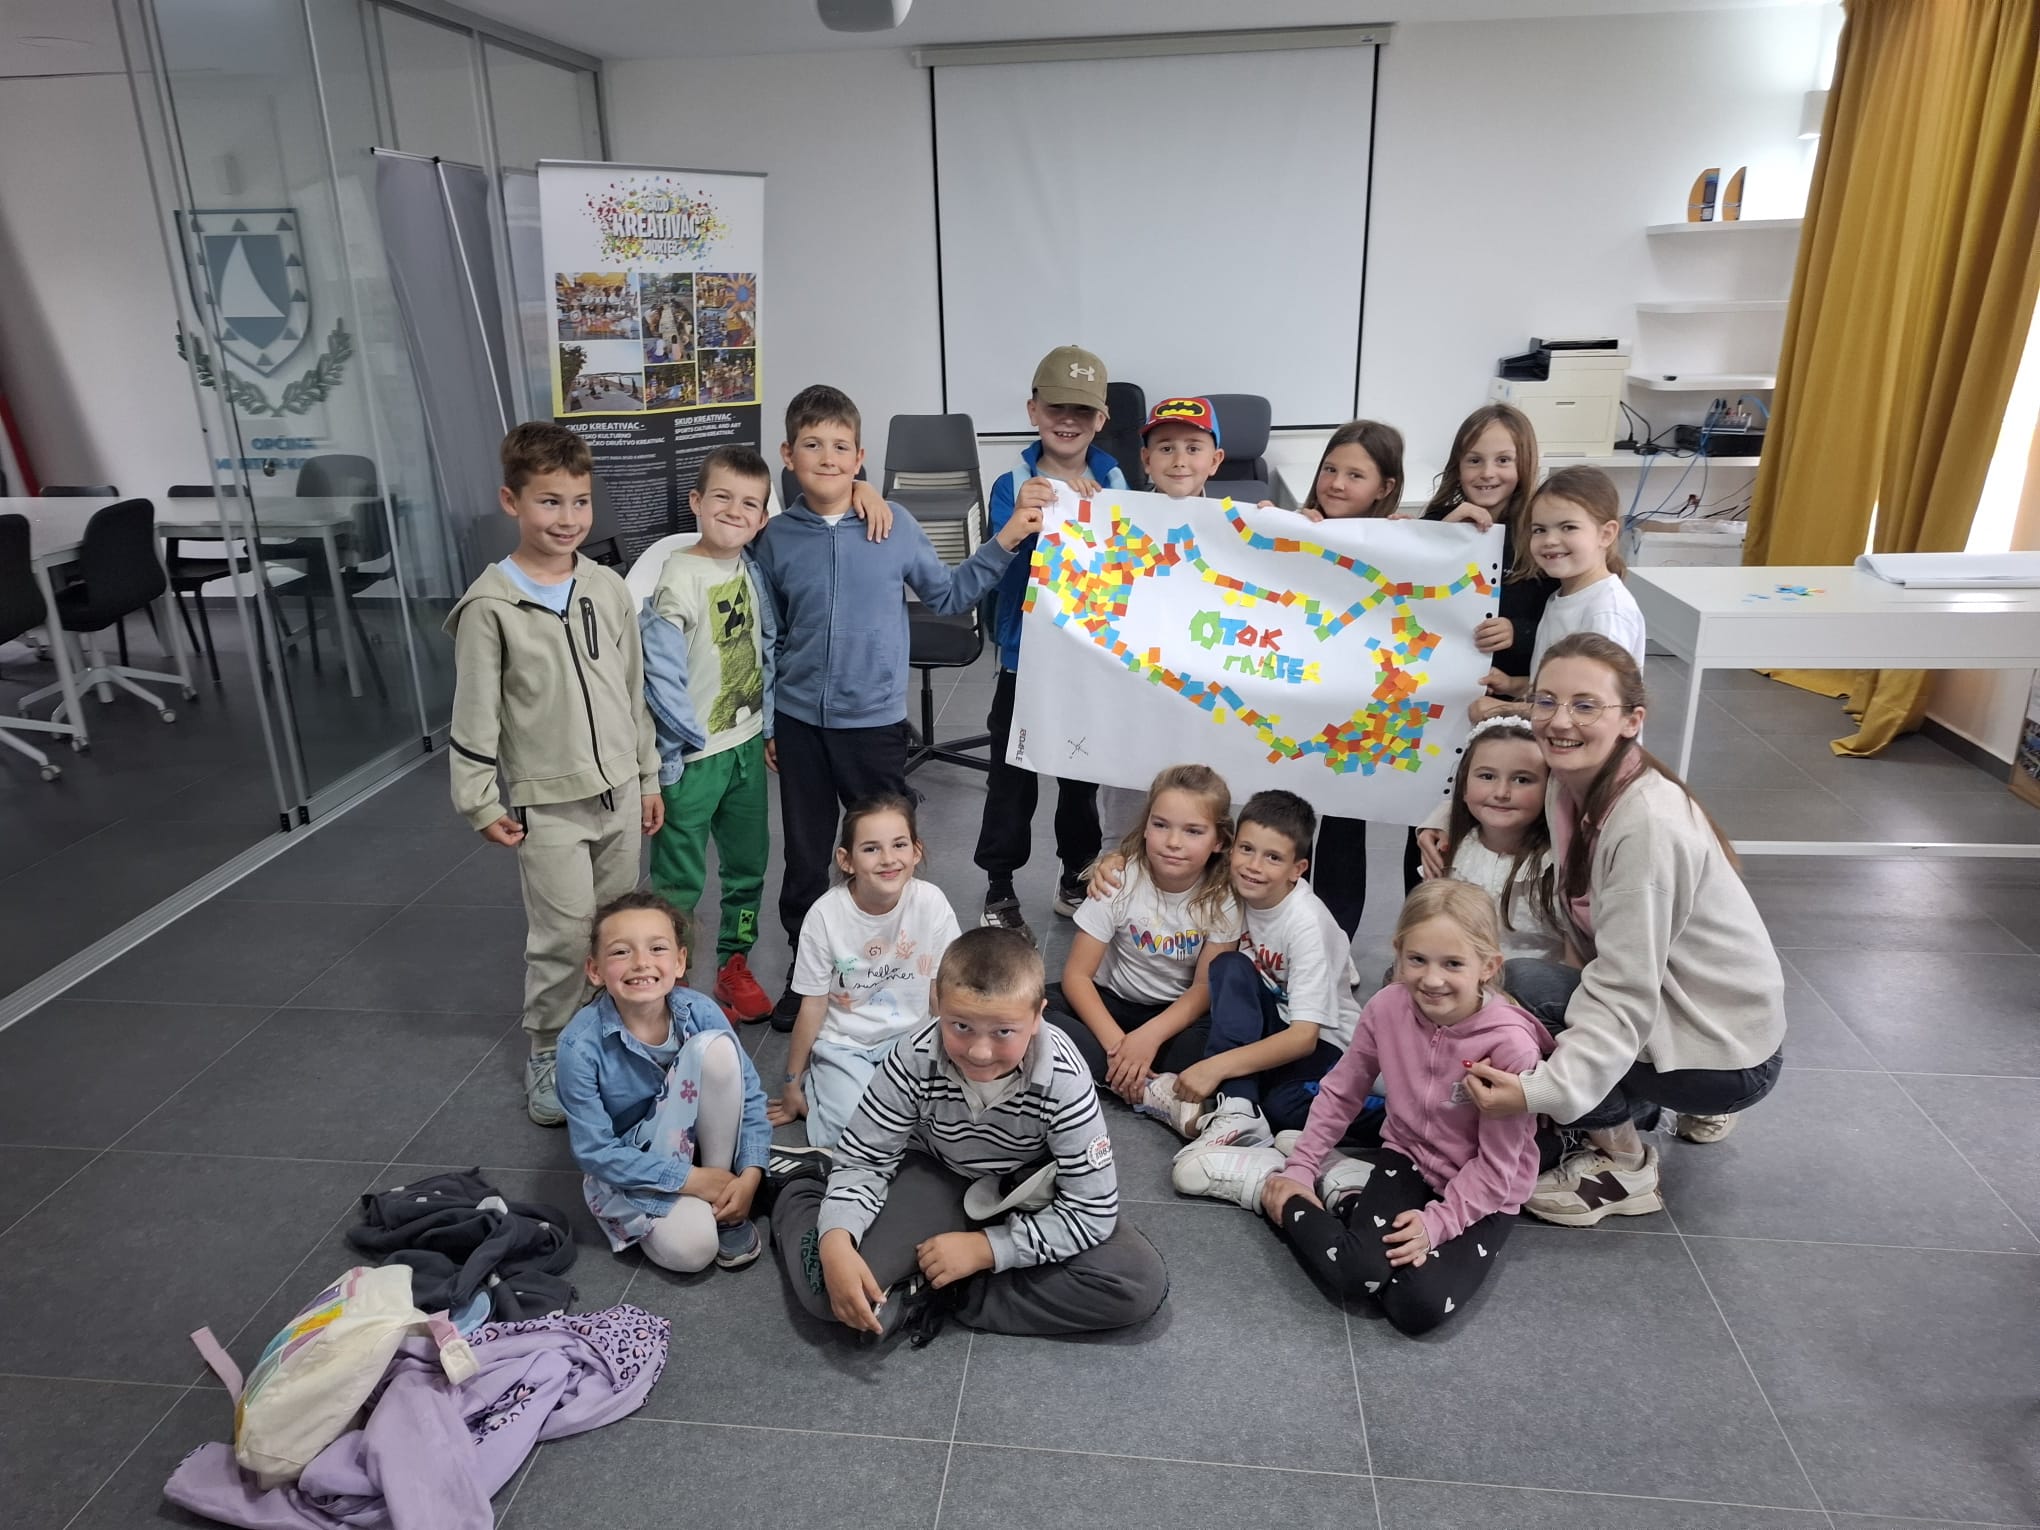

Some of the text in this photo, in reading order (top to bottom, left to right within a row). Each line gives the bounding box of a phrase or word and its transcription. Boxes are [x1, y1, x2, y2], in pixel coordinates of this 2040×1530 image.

[612, 213, 702, 240] KREATIVAC
[589, 422, 640, 431] KREATIVAC
[674, 418, 693, 426] SKUD
[694, 413, 732, 424] KREATIVAC
[1189, 609, 1282, 651] OTOK
